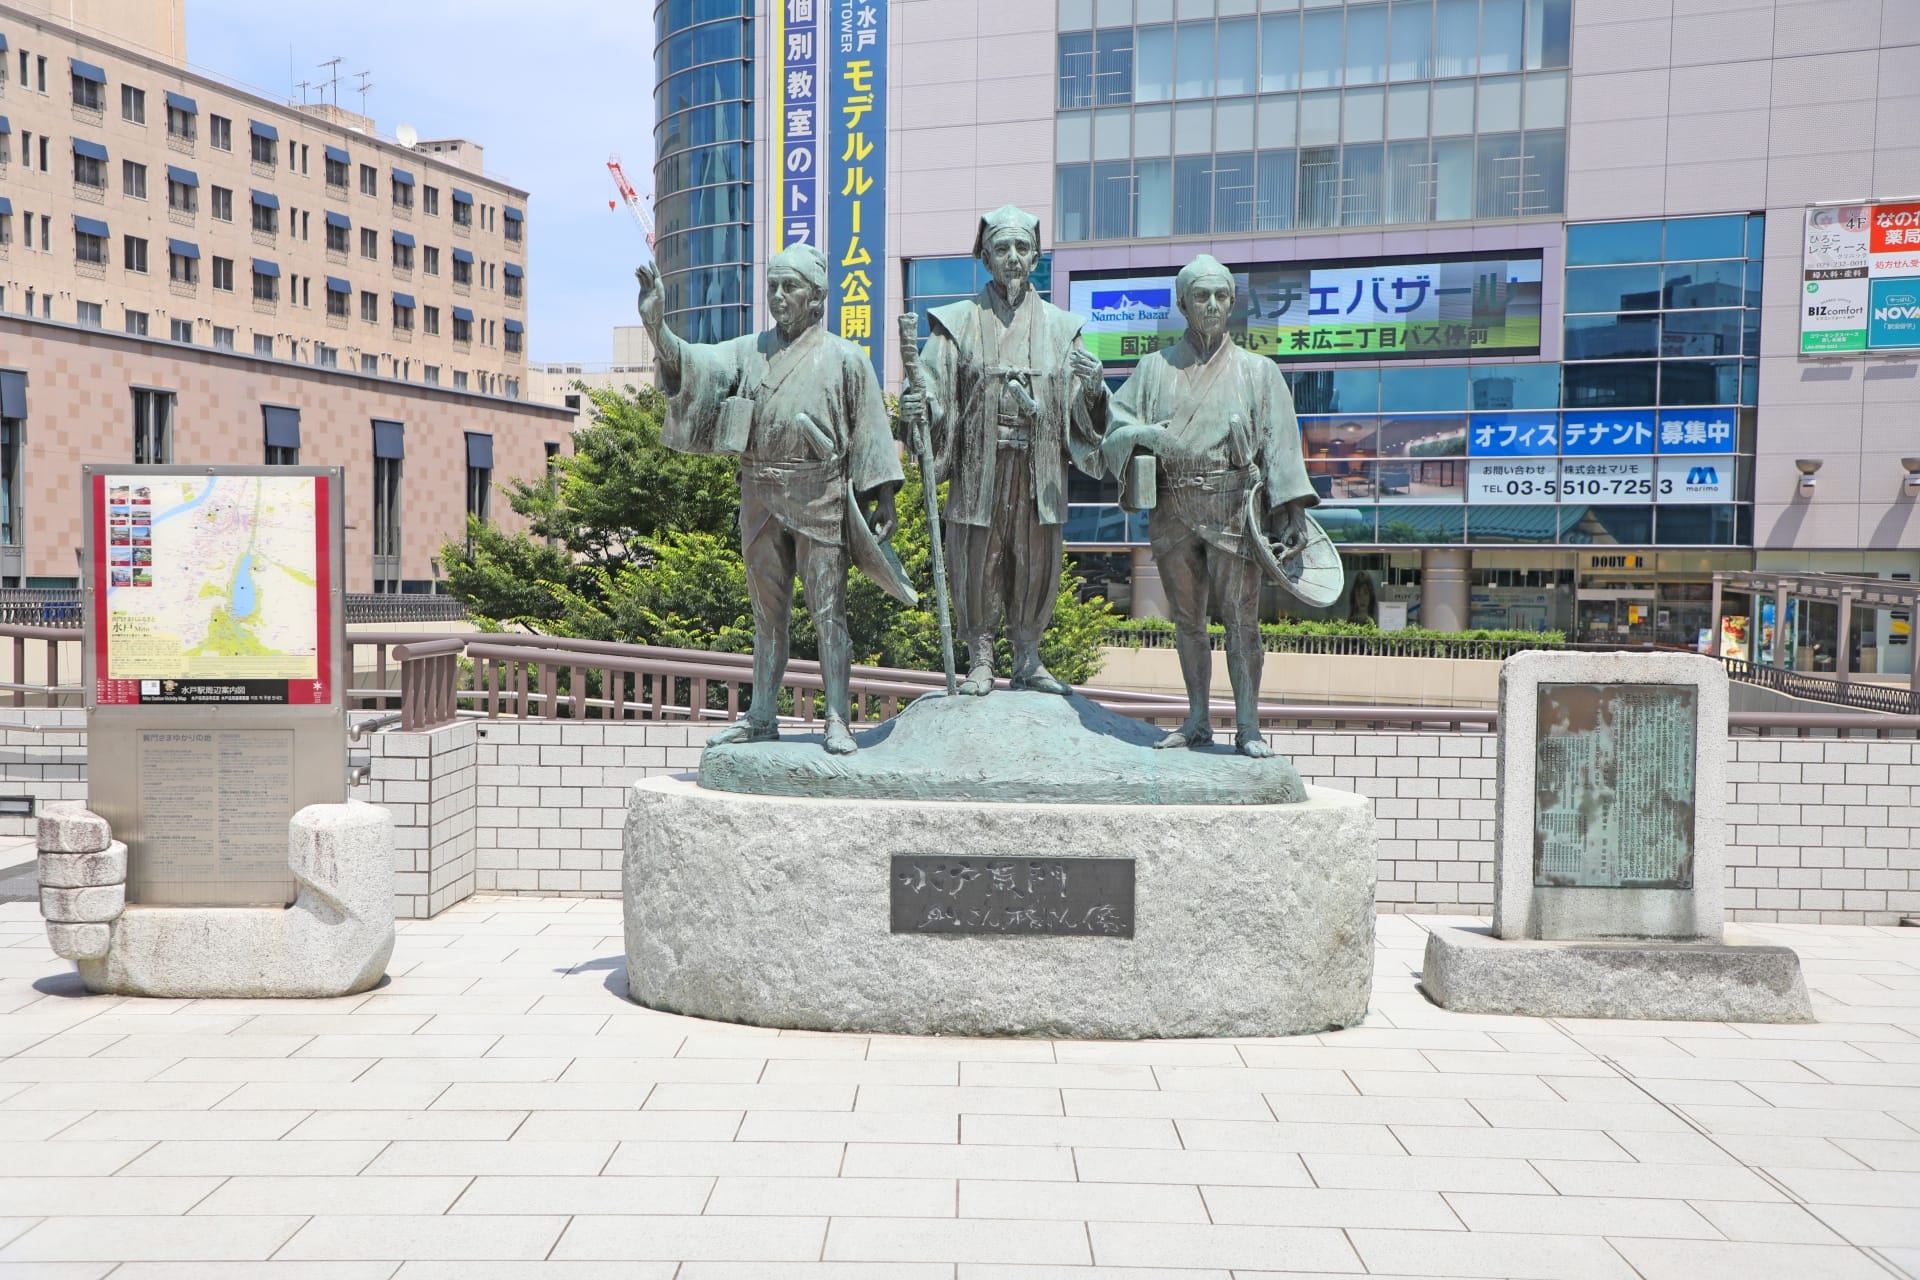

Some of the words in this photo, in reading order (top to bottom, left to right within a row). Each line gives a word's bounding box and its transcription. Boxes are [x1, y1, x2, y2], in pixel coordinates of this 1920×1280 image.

[856, 0, 878, 53] 水戸
[1809, 234, 1841, 244] ひろこ
[1885, 229, 1920, 245] 薬局
[1809, 242, 1867, 254] レディース
[1875, 258, 1920, 270] 処方せん受
[1091, 308, 1136, 322] Namche
[1138, 308, 1171, 321] Bazar
[1808, 303, 1863, 317] BIZcomfort
[1482, 465, 1546, 476] お問い合わせ
[1564, 464, 1639, 475] 株式会社マリモ
[1482, 485, 1503, 494] TEL
